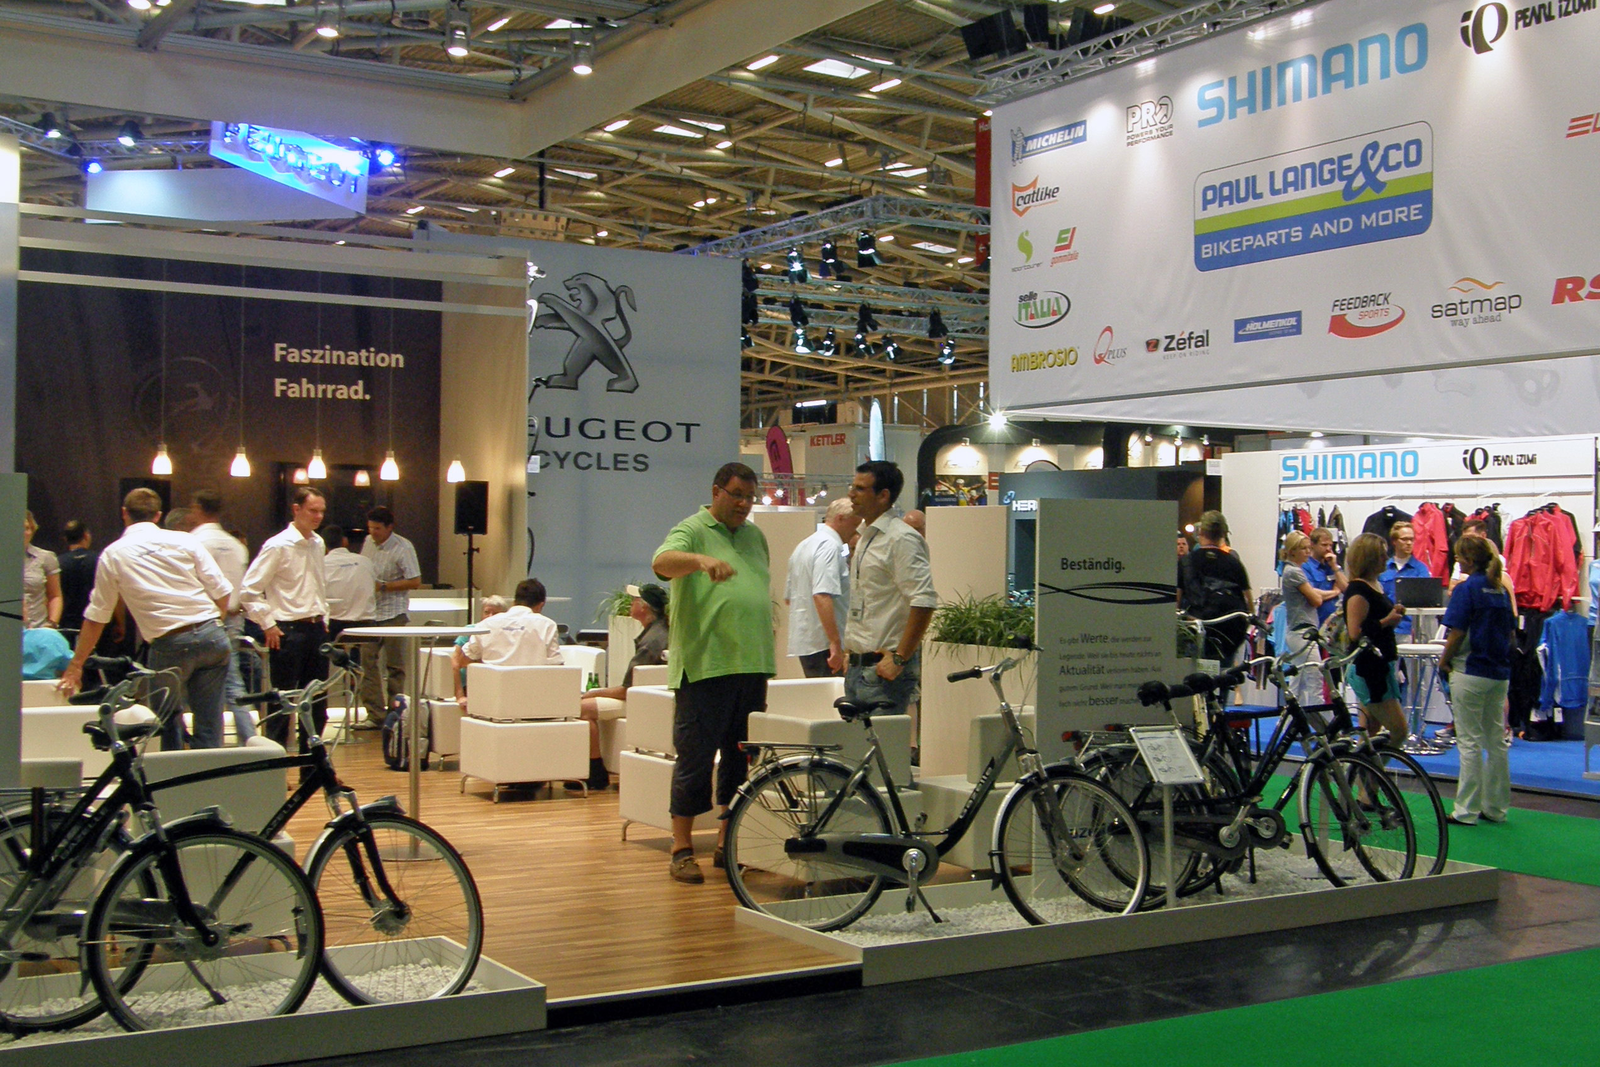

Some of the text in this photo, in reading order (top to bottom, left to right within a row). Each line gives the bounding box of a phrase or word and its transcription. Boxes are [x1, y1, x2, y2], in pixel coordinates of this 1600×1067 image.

[1197, 22, 1428, 128] SHIMANO
[1026, 124, 1085, 151] MICHELIN
[1126, 123, 1173, 141] POWERS YOUR
[1126, 131, 1173, 147] PERFORMANCE
[1016, 185, 1060, 207] catlike
[1202, 175, 1263, 211] PAUL
[1201, 204, 1423, 259] BIKEPARTS AND MORE
[1018, 291, 1038, 303] selle
[1332, 292, 1391, 312] FEEDBACK
[1431, 294, 1522, 319] satmap
[1018, 297, 1062, 322] ITALIA
[1358, 308, 1390, 320] SPORTS
[1451, 313, 1502, 328] way ahead
[1163, 329, 1209, 352] Zéfal
[274, 343, 404, 368] Faszination
[1011, 346, 1078, 373] AMBROSIO
[274, 378, 371, 400] Fahrrad.
[528, 415, 701, 443] UGEOT
[810, 433, 846, 447] KETTLER
[1282, 450, 1419, 481] SHIMANO
[1061, 557, 1126, 574] Beständig.
[1059, 664, 1105, 676] Aktualität
[1088, 694, 1119, 706] besser
